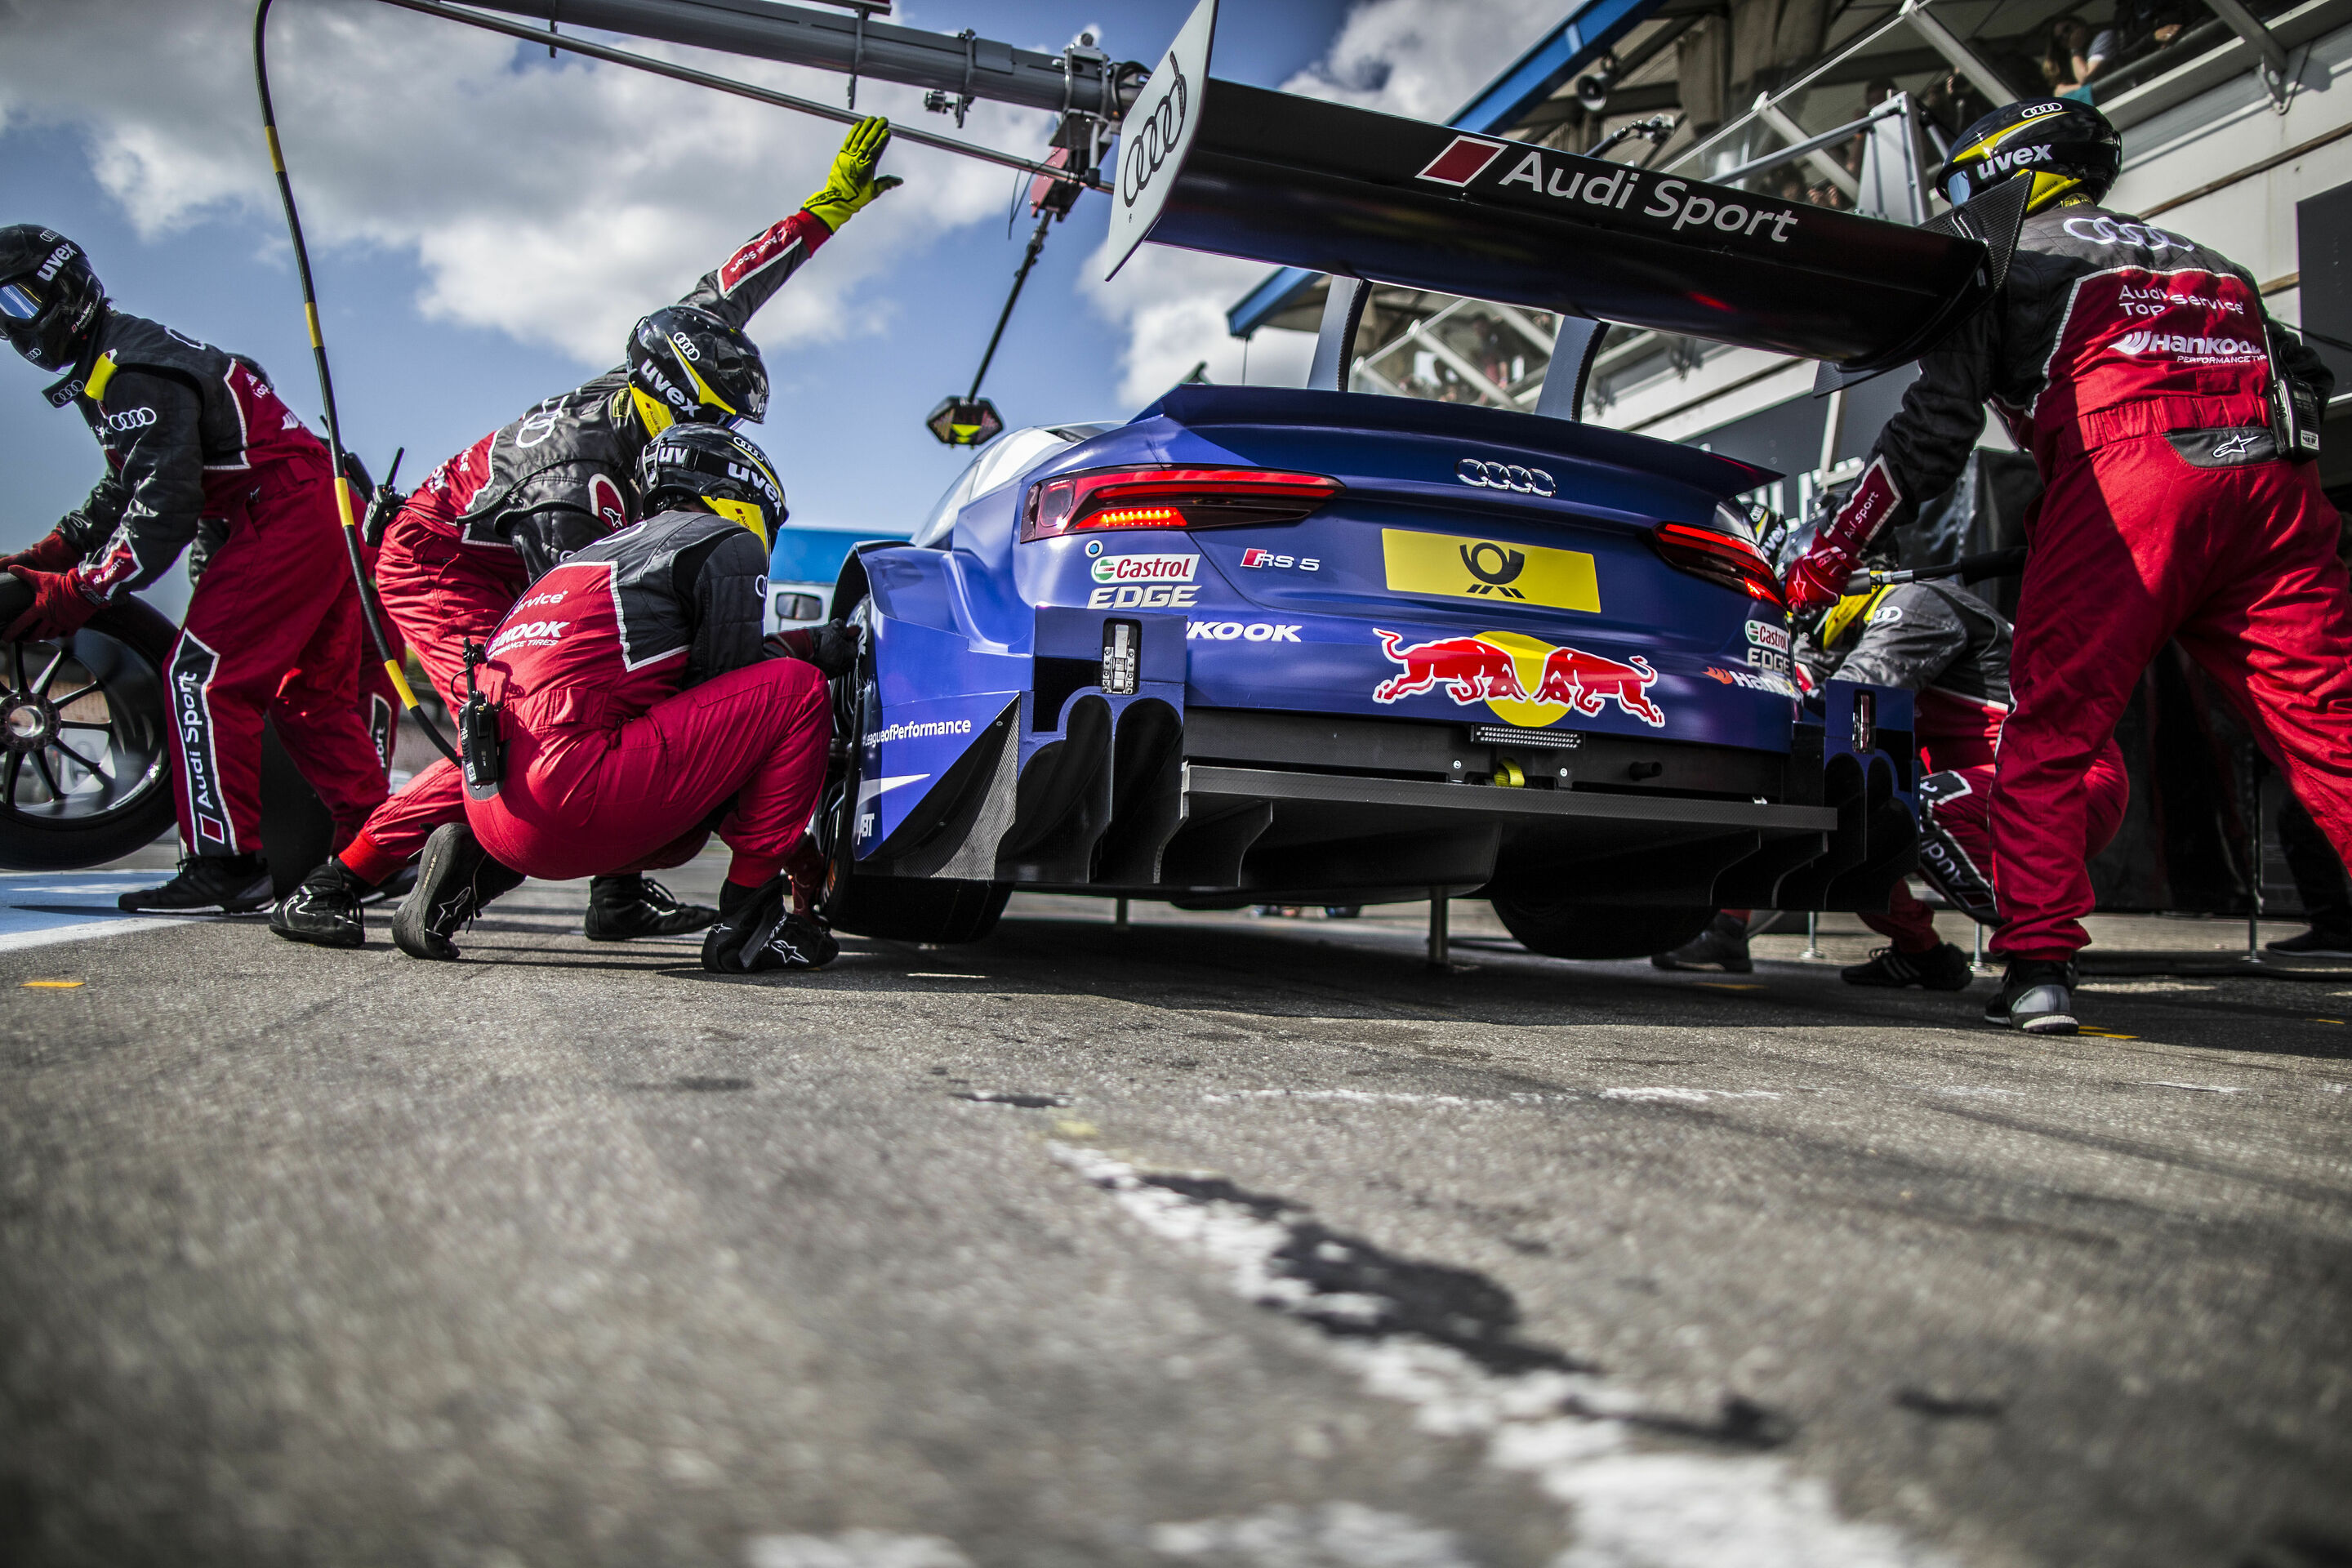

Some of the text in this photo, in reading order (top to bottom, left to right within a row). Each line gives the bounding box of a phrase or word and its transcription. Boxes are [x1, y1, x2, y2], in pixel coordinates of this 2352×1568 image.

[1976, 144, 2053, 180] uvex
[1498, 151, 1798, 243] Audi Sport
[2028, 180, 2060, 206] portsline
[36, 243, 78, 282] uvex
[2118, 284, 2169, 301] Audi
[2118, 302, 2165, 316] Top
[2176, 355, 2251, 364] PERFORMANCE
[639, 358, 702, 417] uvex
[658, 446, 688, 465] uv
[728, 462, 782, 517] uvex
[1116, 557, 1192, 579] Castrol
[1252, 552, 1321, 572] RS 5
[1086, 585, 1202, 609] EDGE
[525, 639, 559, 648] TIRES
[1187, 621, 1303, 643] KOOK
[1759, 625, 1788, 650] Castrol
[1747, 647, 1791, 676] EDGE
[177, 670, 214, 810] Audi Sport
[857, 813, 875, 846] ABT
